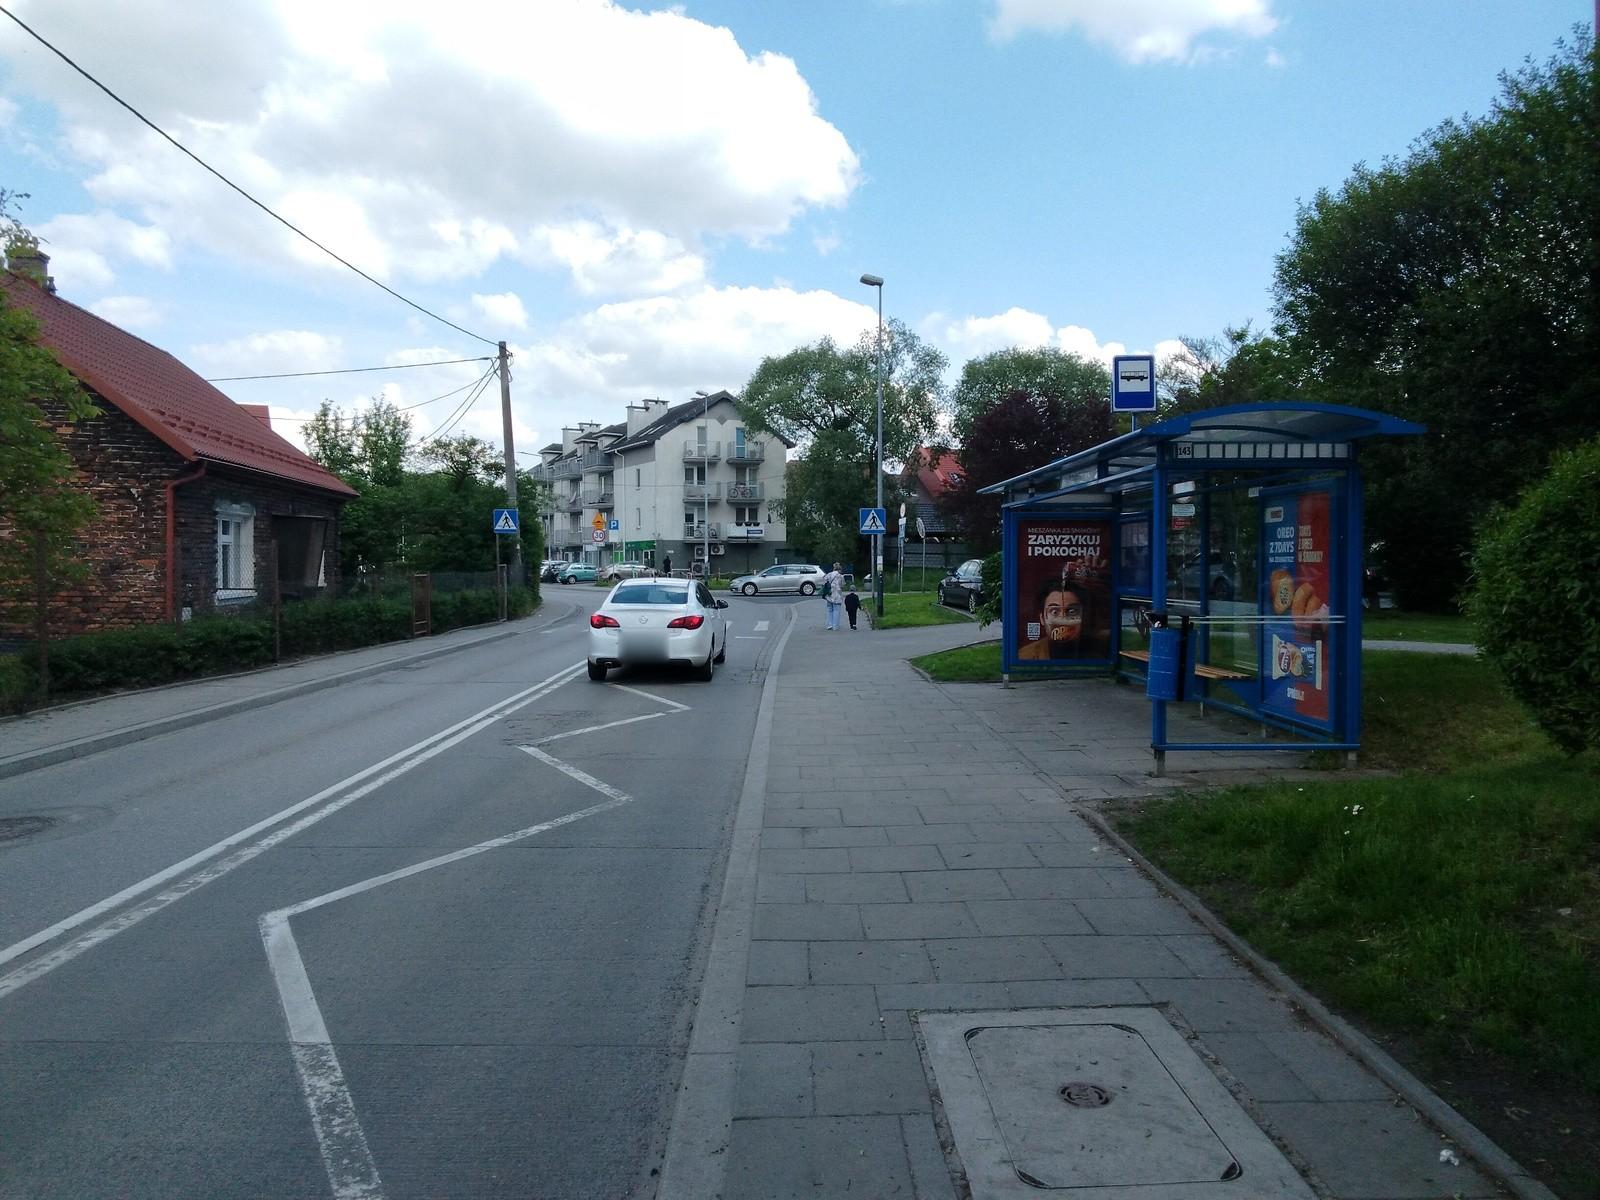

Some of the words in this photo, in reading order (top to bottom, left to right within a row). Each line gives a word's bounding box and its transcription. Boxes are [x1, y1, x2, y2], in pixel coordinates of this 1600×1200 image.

[1178, 446, 1191, 456] 143
[1276, 526, 1295, 539] OREO
[1027, 534, 1101, 545] ZARYZYKUJ
[1027, 546, 1032, 557] I
[1034, 546, 1101, 557] POKOCHAJ
[1274, 541, 1295, 553] 7DAYS
